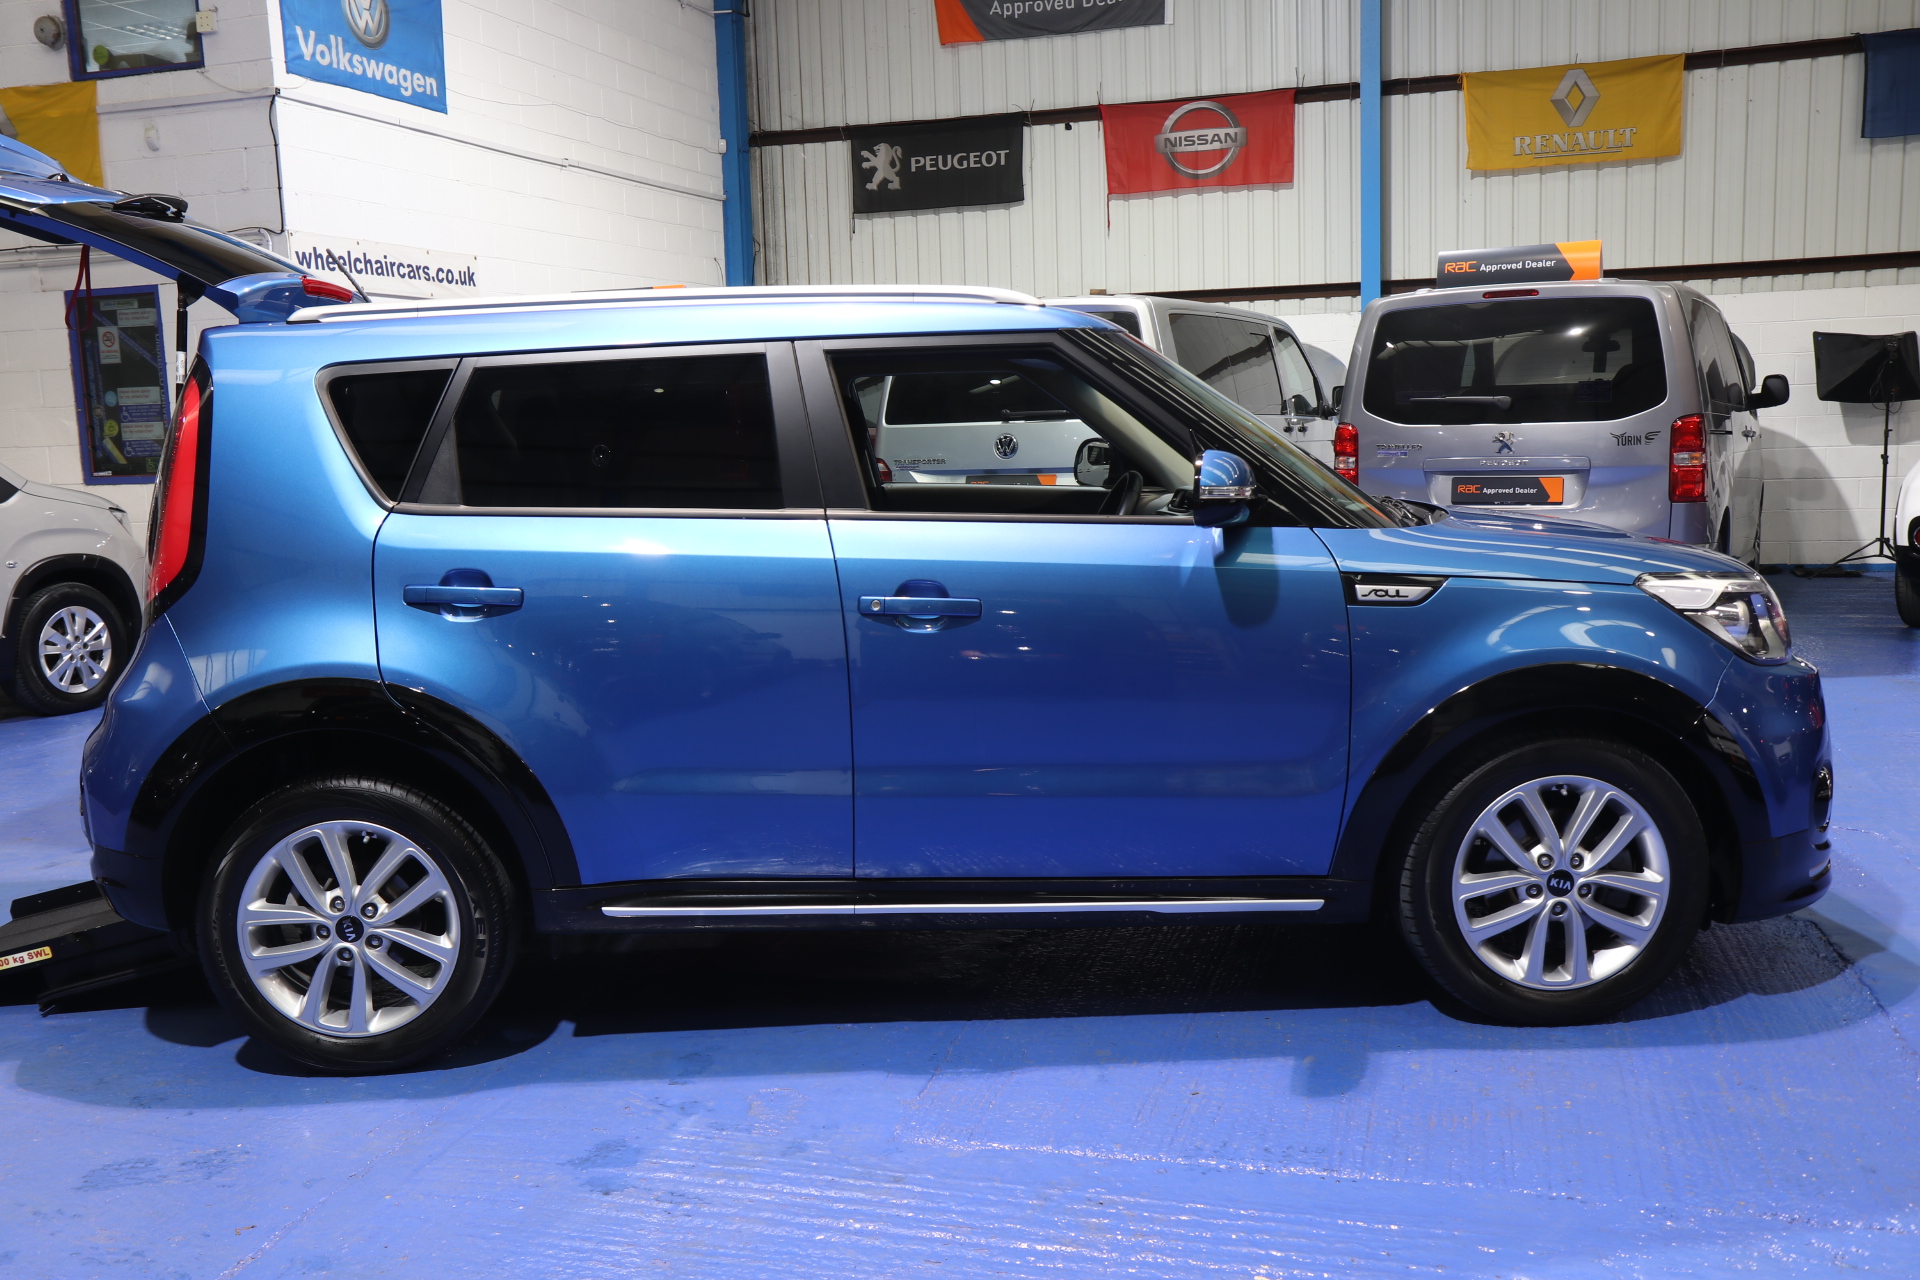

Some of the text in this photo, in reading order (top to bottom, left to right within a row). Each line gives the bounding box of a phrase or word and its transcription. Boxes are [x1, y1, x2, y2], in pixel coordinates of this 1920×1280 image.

[295, 25, 438, 97] Volkswagen
[1163, 132, 1238, 149] NISSAN
[1513, 127, 1637, 156] RENAULT
[910, 149, 1010, 172] PEUGEOT
[294, 246, 477, 287] wheelchaircars.co.uk
[1479, 262, 1523, 273] Approved
[1525, 259, 1557, 269] Dealer
[1482, 486, 1514, 496] Approved
[1515, 486, 1538, 495] Dealer
[1549, 877, 1571, 890] KIA
[12, 955, 25, 964] kg
[27, 949, 50, 960] SWL
